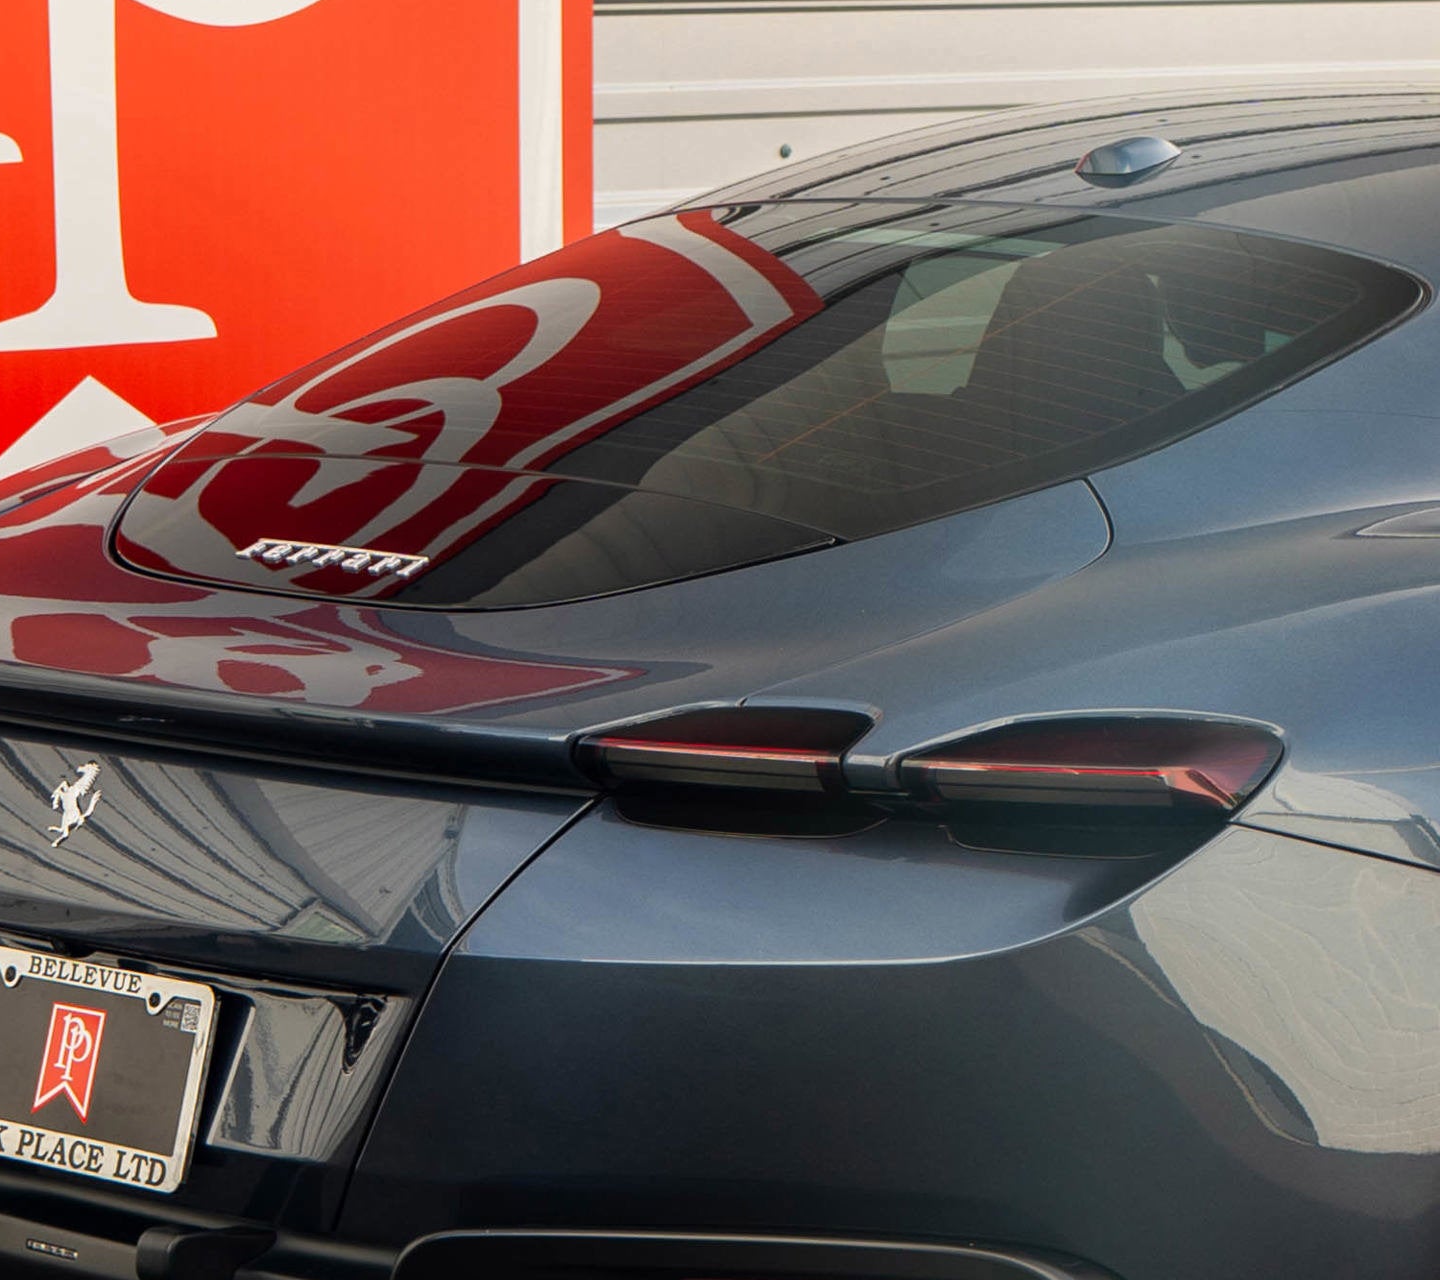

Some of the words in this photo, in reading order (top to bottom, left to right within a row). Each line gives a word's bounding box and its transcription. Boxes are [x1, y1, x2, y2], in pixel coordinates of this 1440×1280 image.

[29, 955, 142, 993] BELLEVUE
[15, 1129, 104, 1173] PLACE
[112, 1150, 167, 1187] LTD
